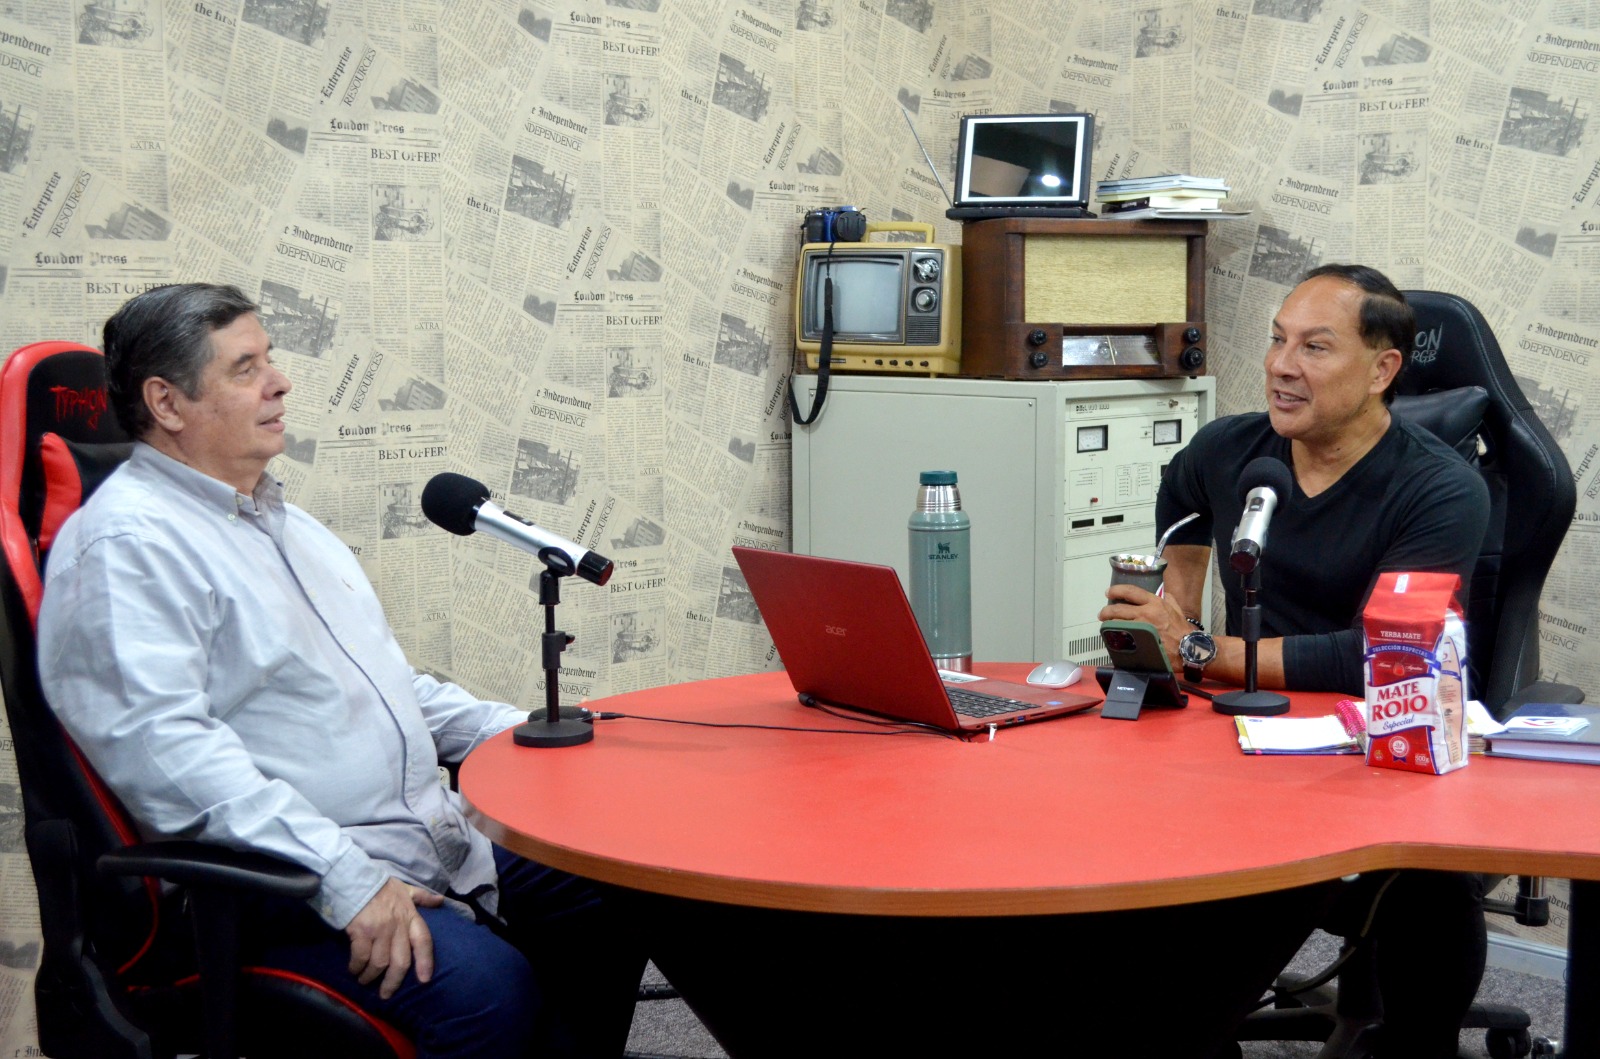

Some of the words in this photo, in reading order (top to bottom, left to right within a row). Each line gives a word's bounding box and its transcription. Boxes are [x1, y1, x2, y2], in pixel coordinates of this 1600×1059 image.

[195, 2, 213, 17] the
[1216, 6, 1231, 19] the
[741, 9, 783, 38] Independence
[0, 31, 52, 56] pendence
[603, 40, 625, 53] BEST
[627, 44, 660, 57] OFFER!
[1336, 11, 1370, 70] RESOURCES
[1544, 33, 1600, 52] Independen
[1073, 54, 1118, 72] Independence
[343, 49, 377, 107] RESOURCES
[681, 89, 695, 102] the
[1359, 100, 1388, 113] BEST
[1389, 97, 1430, 111] OFFER!
[538, 106, 589, 135] Independence
[778, 124, 802, 171] RESOURCES
[1455, 135, 1472, 147] the
[371, 148, 399, 161] BEST
[401, 150, 442, 164] OFFER!
[1285, 176, 1339, 198] Independence
[53, 170, 92, 238] RESOURCES
[467, 196, 483, 210] the
[291, 225, 354, 253] Independence
[585, 226, 612, 281] RESOURCES
[742, 267, 783, 292] Independence
[1213, 265, 1227, 278] the
[86, 282, 120, 294] BEST
[606, 315, 628, 326] BEST
[631, 315, 664, 326] OFFER!
[1535, 322, 1599, 348] Independence
[683, 352, 698, 365] the
[351, 352, 384, 413] RESOURCES
[542, 387, 592, 411] Independence
[378, 448, 406, 461] BEST
[408, 446, 448, 459] OFFER!
[590, 497, 616, 552] RESOURCES
[610, 582, 633, 593] BEST
[634, 578, 666, 590] OFFER!
[686, 610, 700, 622] the
[825, 625, 848, 636] acer
[1380, 630, 1402, 639] YERBA
[1402, 632, 1421, 640] MATE
[1377, 681, 1420, 702] MATE
[1372, 694, 1428, 722] ROJO
[1383, 713, 1415, 732] Especial
